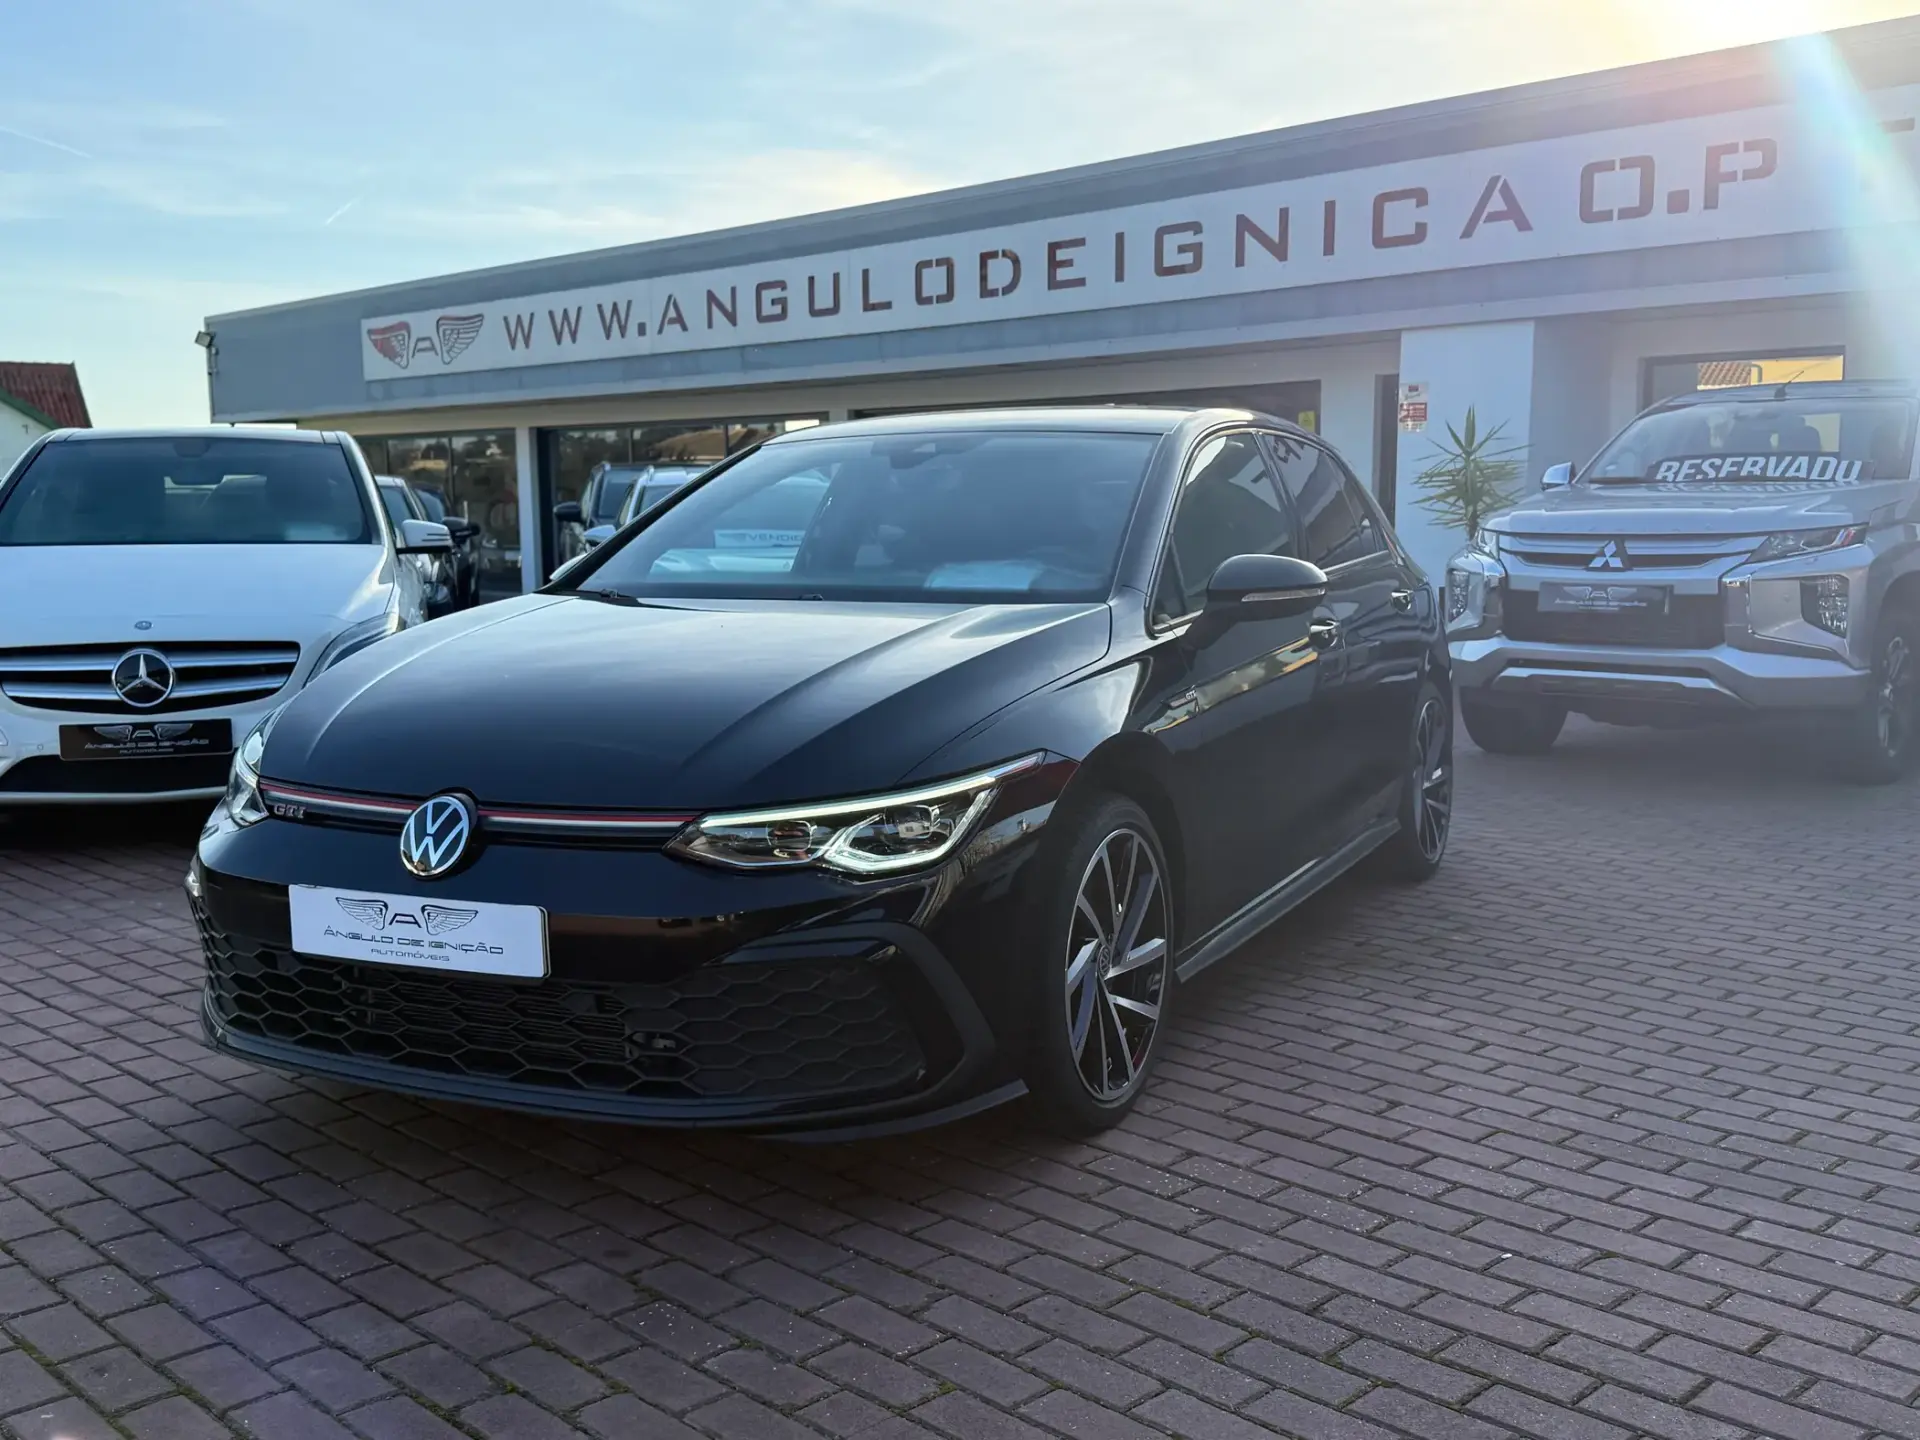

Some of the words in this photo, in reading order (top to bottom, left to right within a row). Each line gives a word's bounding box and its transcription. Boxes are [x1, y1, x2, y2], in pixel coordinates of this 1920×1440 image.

[274, 803, 306, 819] GTI
[323, 925, 394, 945] ÂNGULO
[397, 936, 425, 948] DE
[428, 940, 504, 955] IGNIÇÃO
